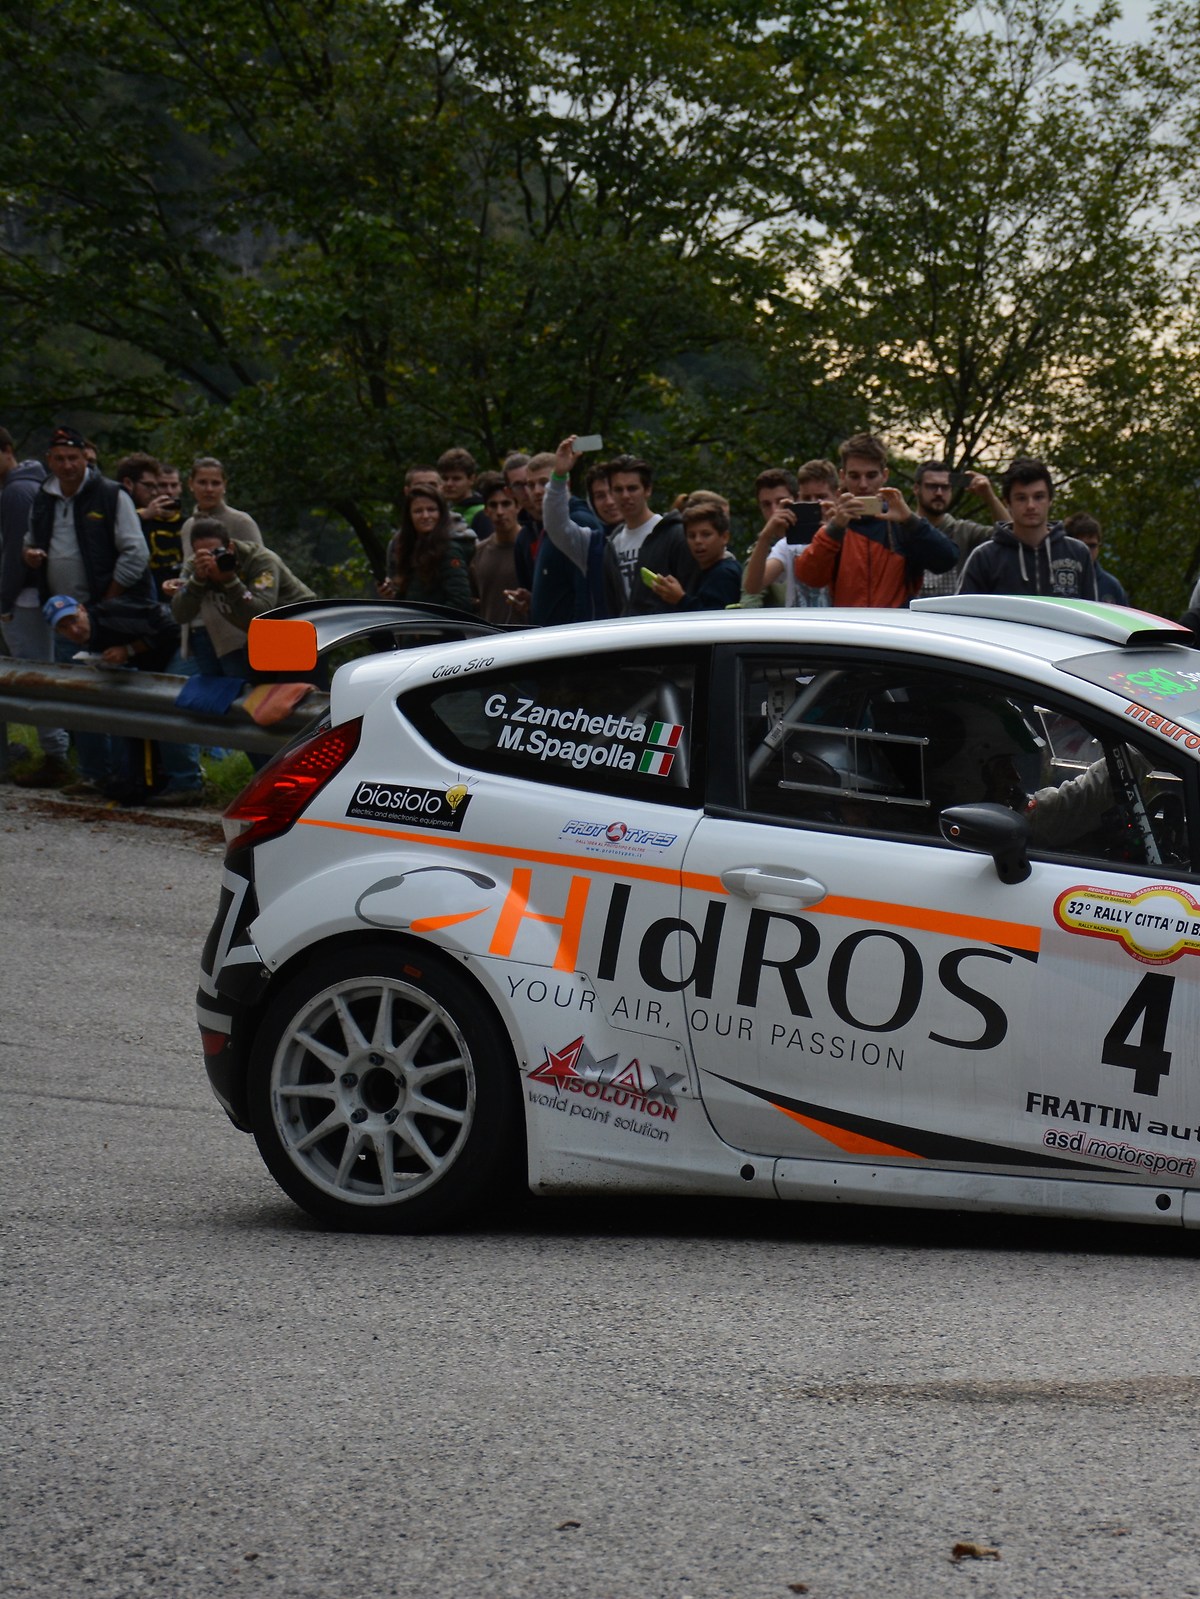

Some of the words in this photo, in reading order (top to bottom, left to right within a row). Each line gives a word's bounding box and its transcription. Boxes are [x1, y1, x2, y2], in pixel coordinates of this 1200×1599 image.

[1058, 572, 1075, 585] 69
[432, 664, 462, 680] Ciao
[464, 656, 495, 672] Siro
[484, 694, 648, 742] G.Zanchetta
[497, 725, 636, 770] M.Spagolla
[351, 808, 373, 817] electric
[388, 812, 419, 823] electronic
[419, 817, 454, 827] equipment
[356, 783, 442, 814] biasiolo
[1068, 901, 1091, 915] 32°
[1093, 906, 1133, 923] RALLY
[1135, 913, 1174, 930] CITTA'
[1175, 920, 1189, 934] DI
[507, 975, 597, 1013] YOUR
[612, 996, 671, 1029] AIR,
[691, 1009, 753, 1041] OUR
[772, 1024, 905, 1071] PASSION
[1101, 971, 1176, 1097] 4
[529, 1091, 568, 1112] world
[569, 1103, 612, 1124] paint
[614, 1117, 670, 1142] solution
[1025, 1091, 1142, 1133] FRATTIN
[1045, 1131, 1084, 1151] asd
[1087, 1140, 1195, 1175] motorsport
